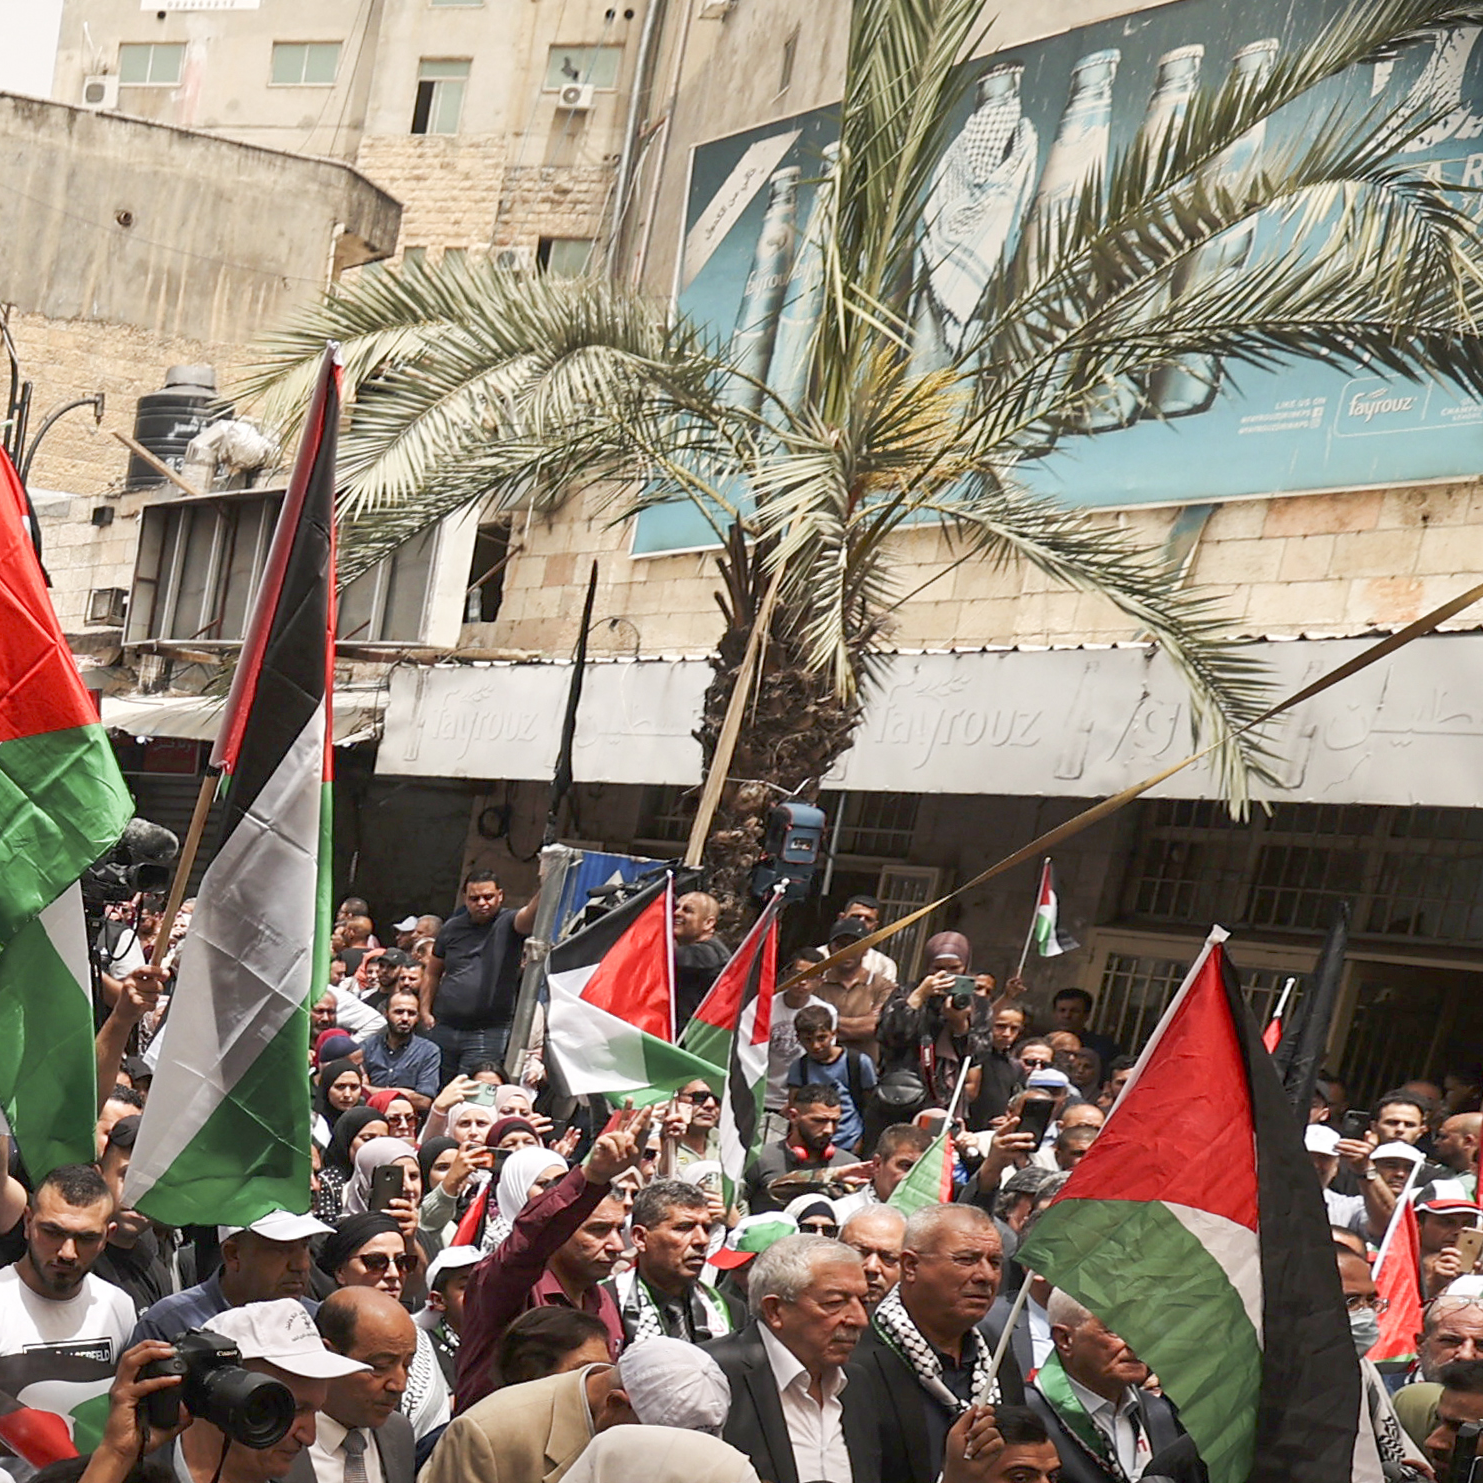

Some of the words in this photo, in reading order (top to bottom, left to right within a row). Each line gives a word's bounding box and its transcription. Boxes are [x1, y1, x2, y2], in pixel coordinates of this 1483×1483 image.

[1348, 392, 1415, 423] fayrouz
[432, 689, 539, 761] fayrouz
[872, 680, 1044, 770] fayrouz
[216, 1349, 238, 1357] Canon
